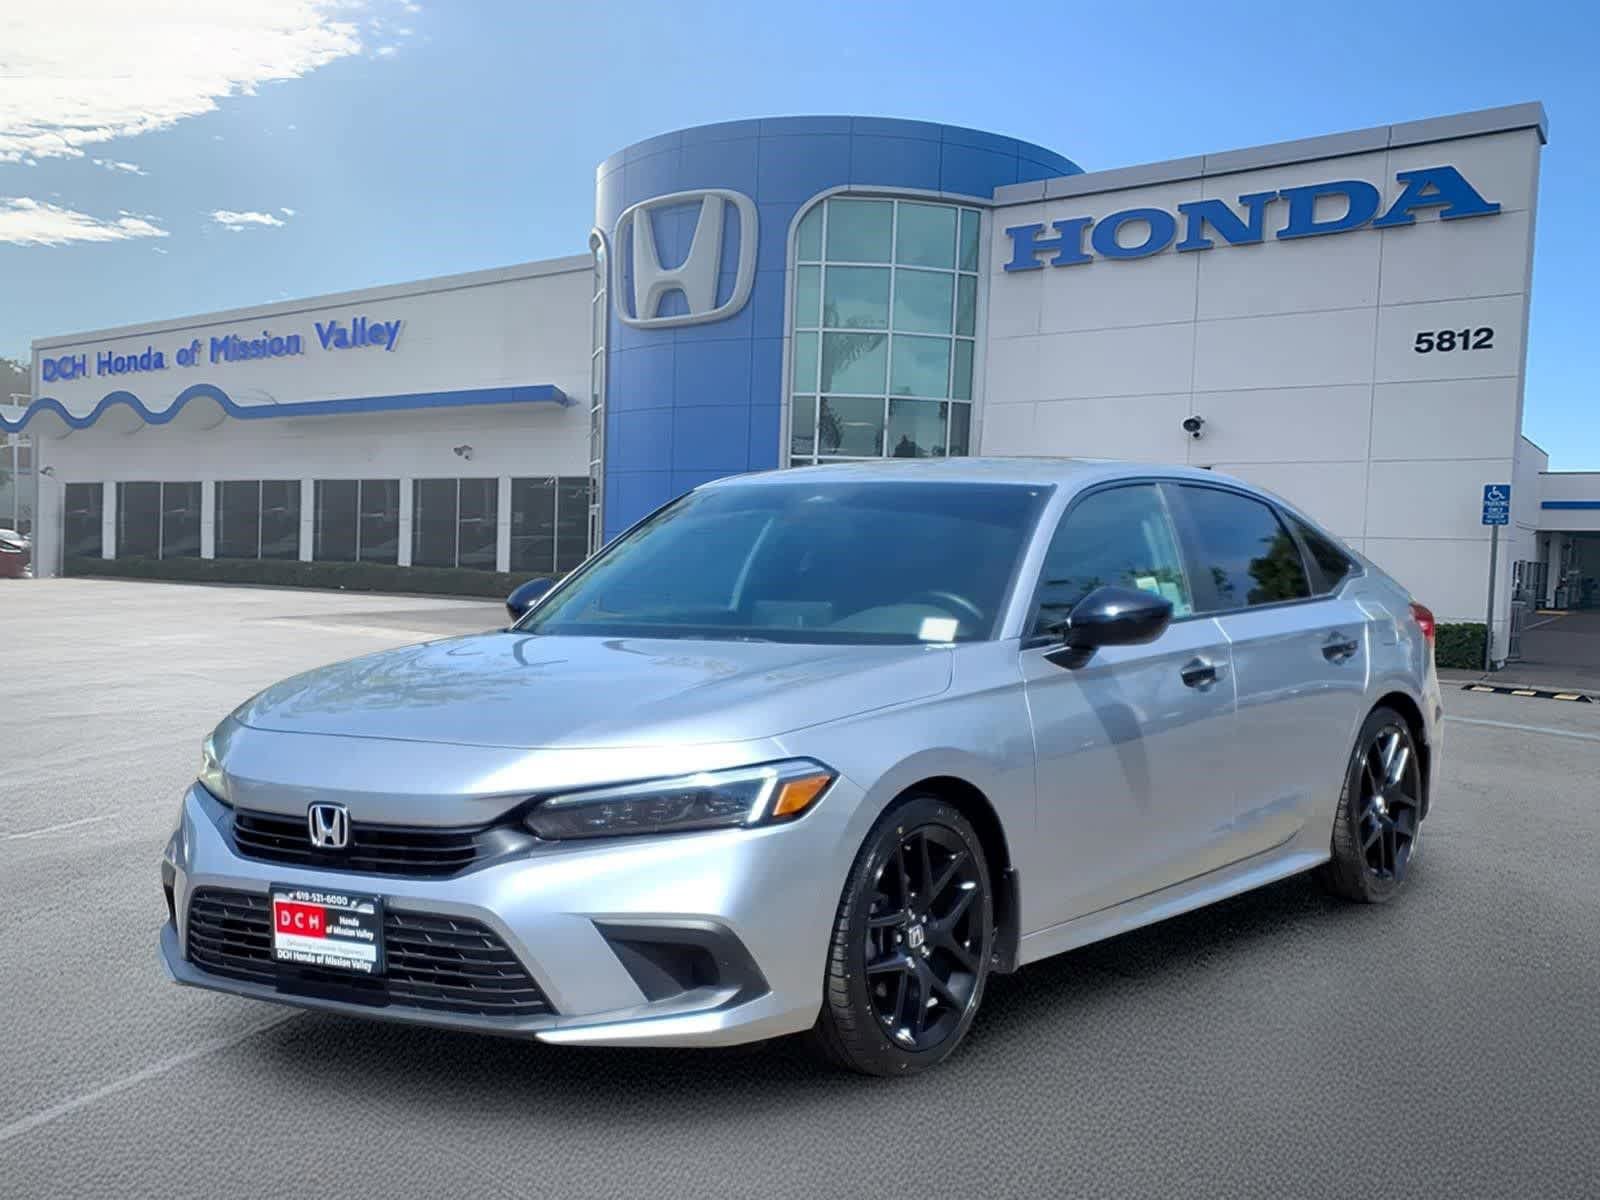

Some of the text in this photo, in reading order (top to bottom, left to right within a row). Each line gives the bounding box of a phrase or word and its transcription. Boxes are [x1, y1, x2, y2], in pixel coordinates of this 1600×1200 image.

[1003, 165, 1502, 272] HONDA
[43, 316, 402, 382] DCH Honda of Mission Valley
[1414, 327, 1494, 353] 5812
[325, 924, 374, 942] of Mission Valley
[339, 916, 360, 927] Honda
[293, 950, 316, 963] Honda
[316, 953, 324, 964] of
[325, 955, 351, 969] Mission
[351, 959, 373, 974] Valley
